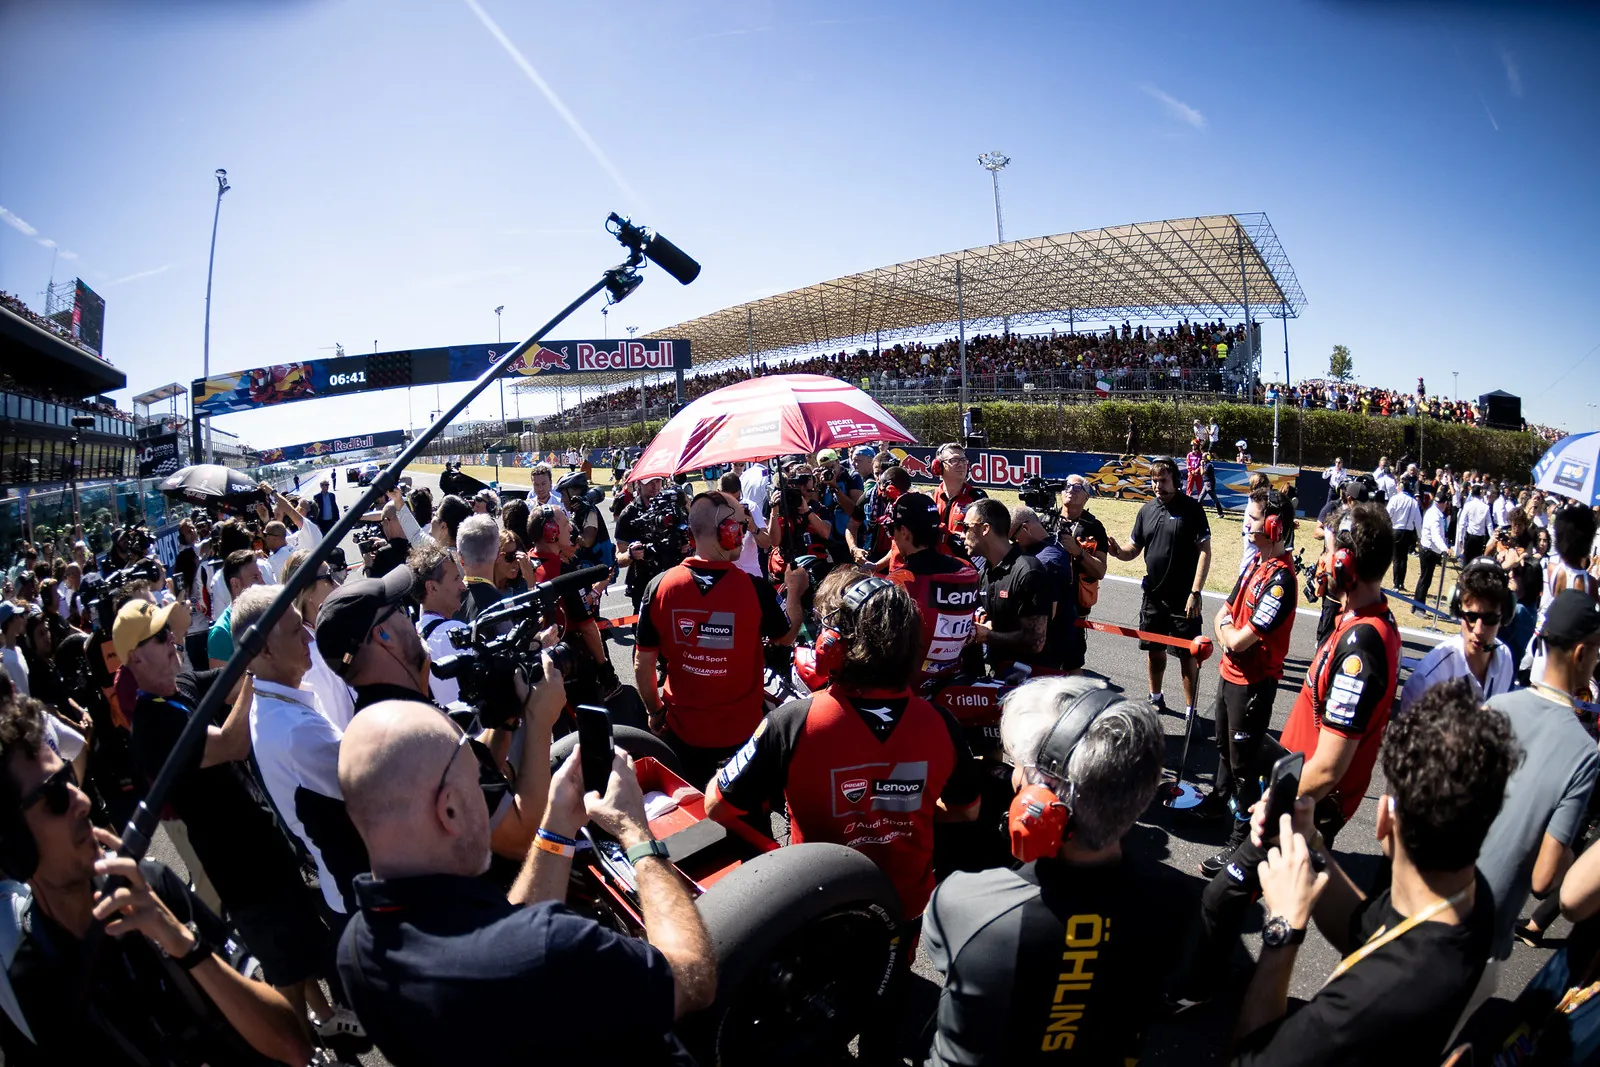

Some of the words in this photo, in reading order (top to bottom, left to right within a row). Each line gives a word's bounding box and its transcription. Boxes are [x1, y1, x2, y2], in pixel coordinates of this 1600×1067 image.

[329, 371, 366, 386] 06:41
[701, 624, 730, 634] Lenovo
[687, 653, 705, 661] Audi
[705, 655, 728, 663] Sport
[956, 694, 989, 706] riello
[983, 726, 1001, 738] FLE
[844, 781, 866, 789] DUCATI
[876, 781, 919, 791] Lenovo
[856, 819, 881, 829] Audi
[877, 951, 897, 996] MICHELIN
[1041, 913, 1111, 1052] ÖHLINS
